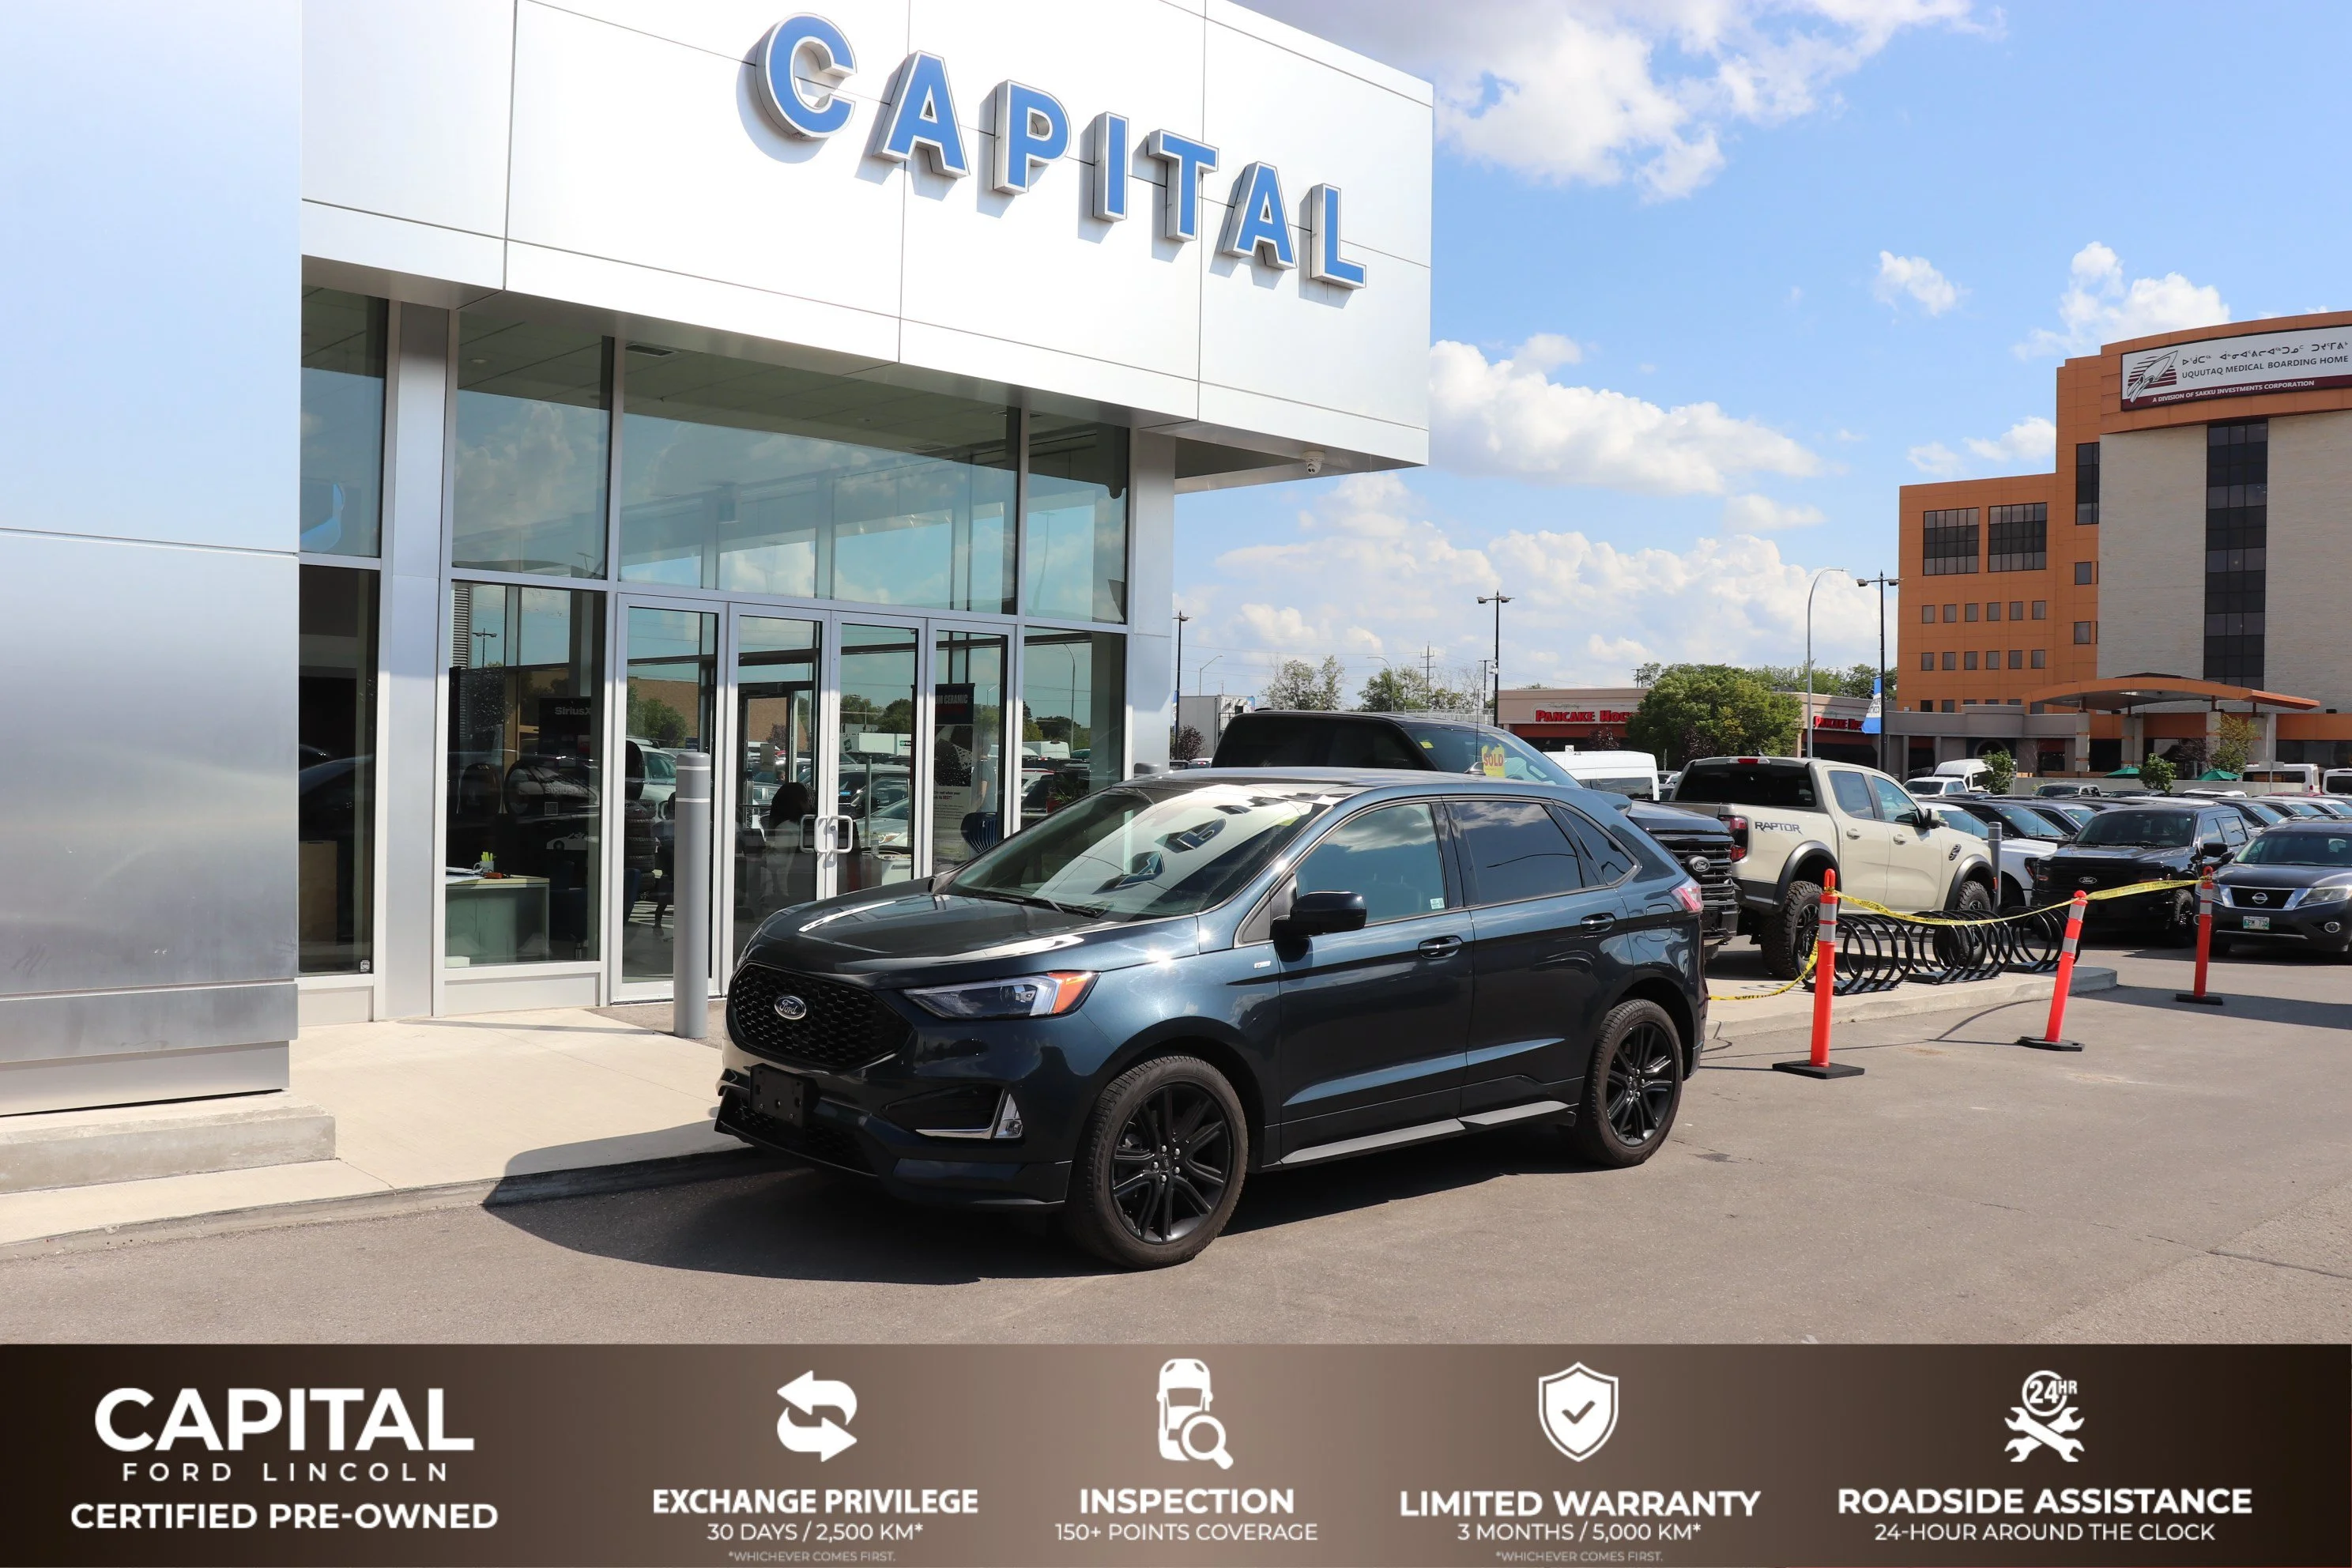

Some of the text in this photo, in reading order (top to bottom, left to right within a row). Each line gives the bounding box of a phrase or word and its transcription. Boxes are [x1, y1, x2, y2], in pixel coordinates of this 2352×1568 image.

[755, 11, 1367, 291] CAPITAL
[2182, 355, 2349, 379] UQUUTAQ MEDICAL BOARDING HOME
[2158, 393, 2185, 402] DIVISION
[2217, 384, 2263, 394] INVESTMENTS
[2263, 380, 2315, 390] CORPORATION
[1536, 710, 1595, 722] PANCAKE
[1483, 753, 1504, 766] SOLD
[1755, 821, 1804, 835] RAPTOR
